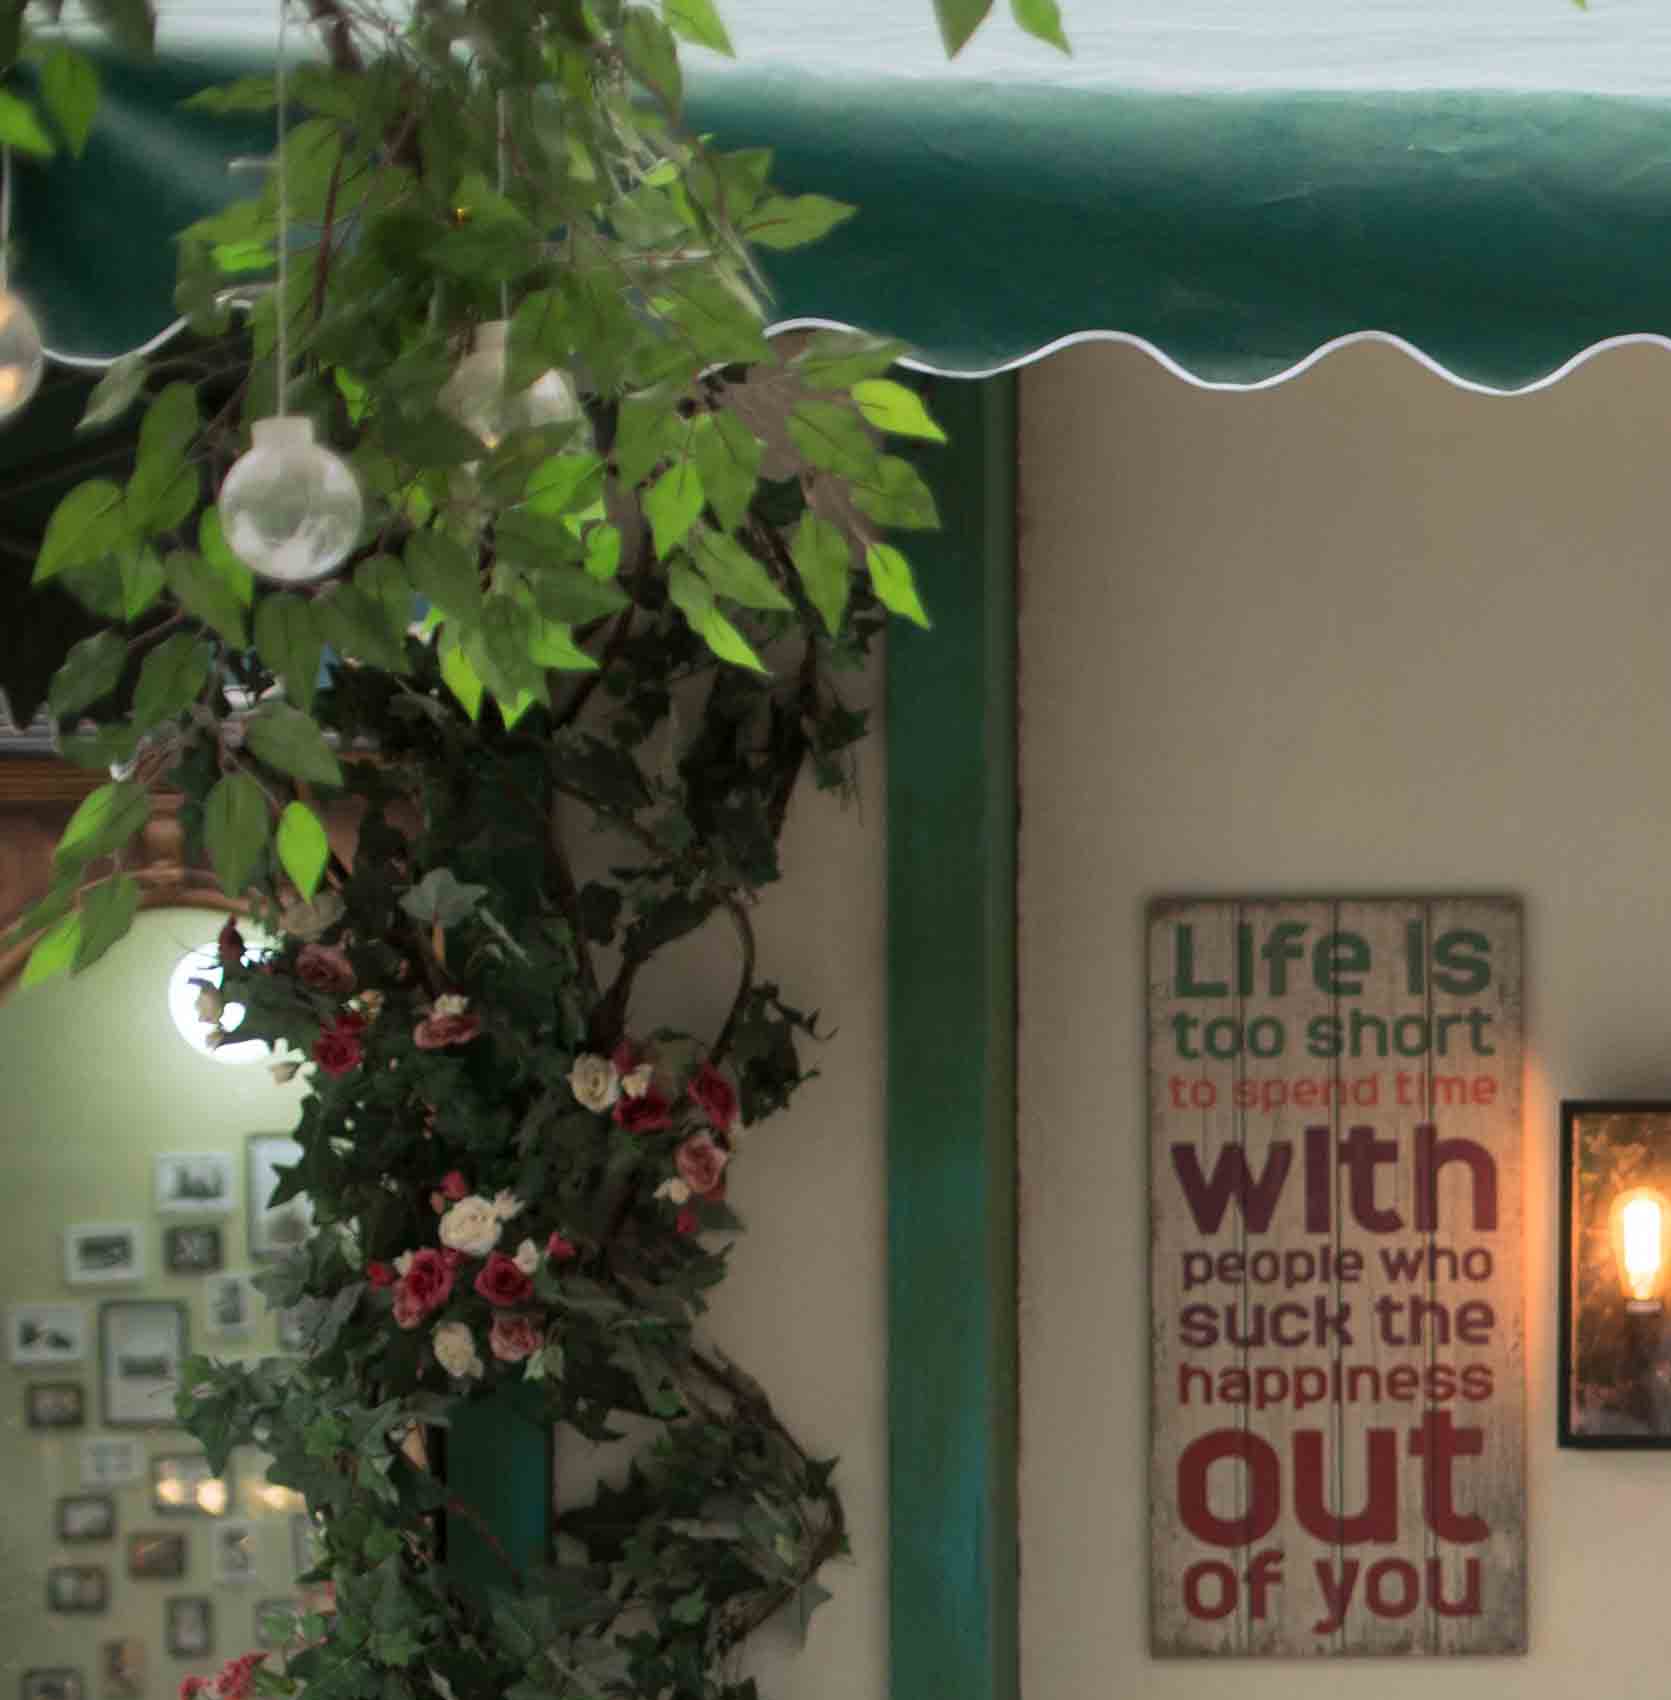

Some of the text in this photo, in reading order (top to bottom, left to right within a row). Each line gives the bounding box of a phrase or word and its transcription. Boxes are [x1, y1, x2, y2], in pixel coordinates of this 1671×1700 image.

[1172, 1007, 1495, 1059] too short
[1169, 1075, 1217, 1110] to
[1233, 1072, 1378, 1115] spend
[1182, 1245, 1494, 1290] people who
[1178, 1293, 1496, 1349] suck the
[1176, 1409, 1492, 1547] out
[1183, 1550, 1483, 1636] of you
